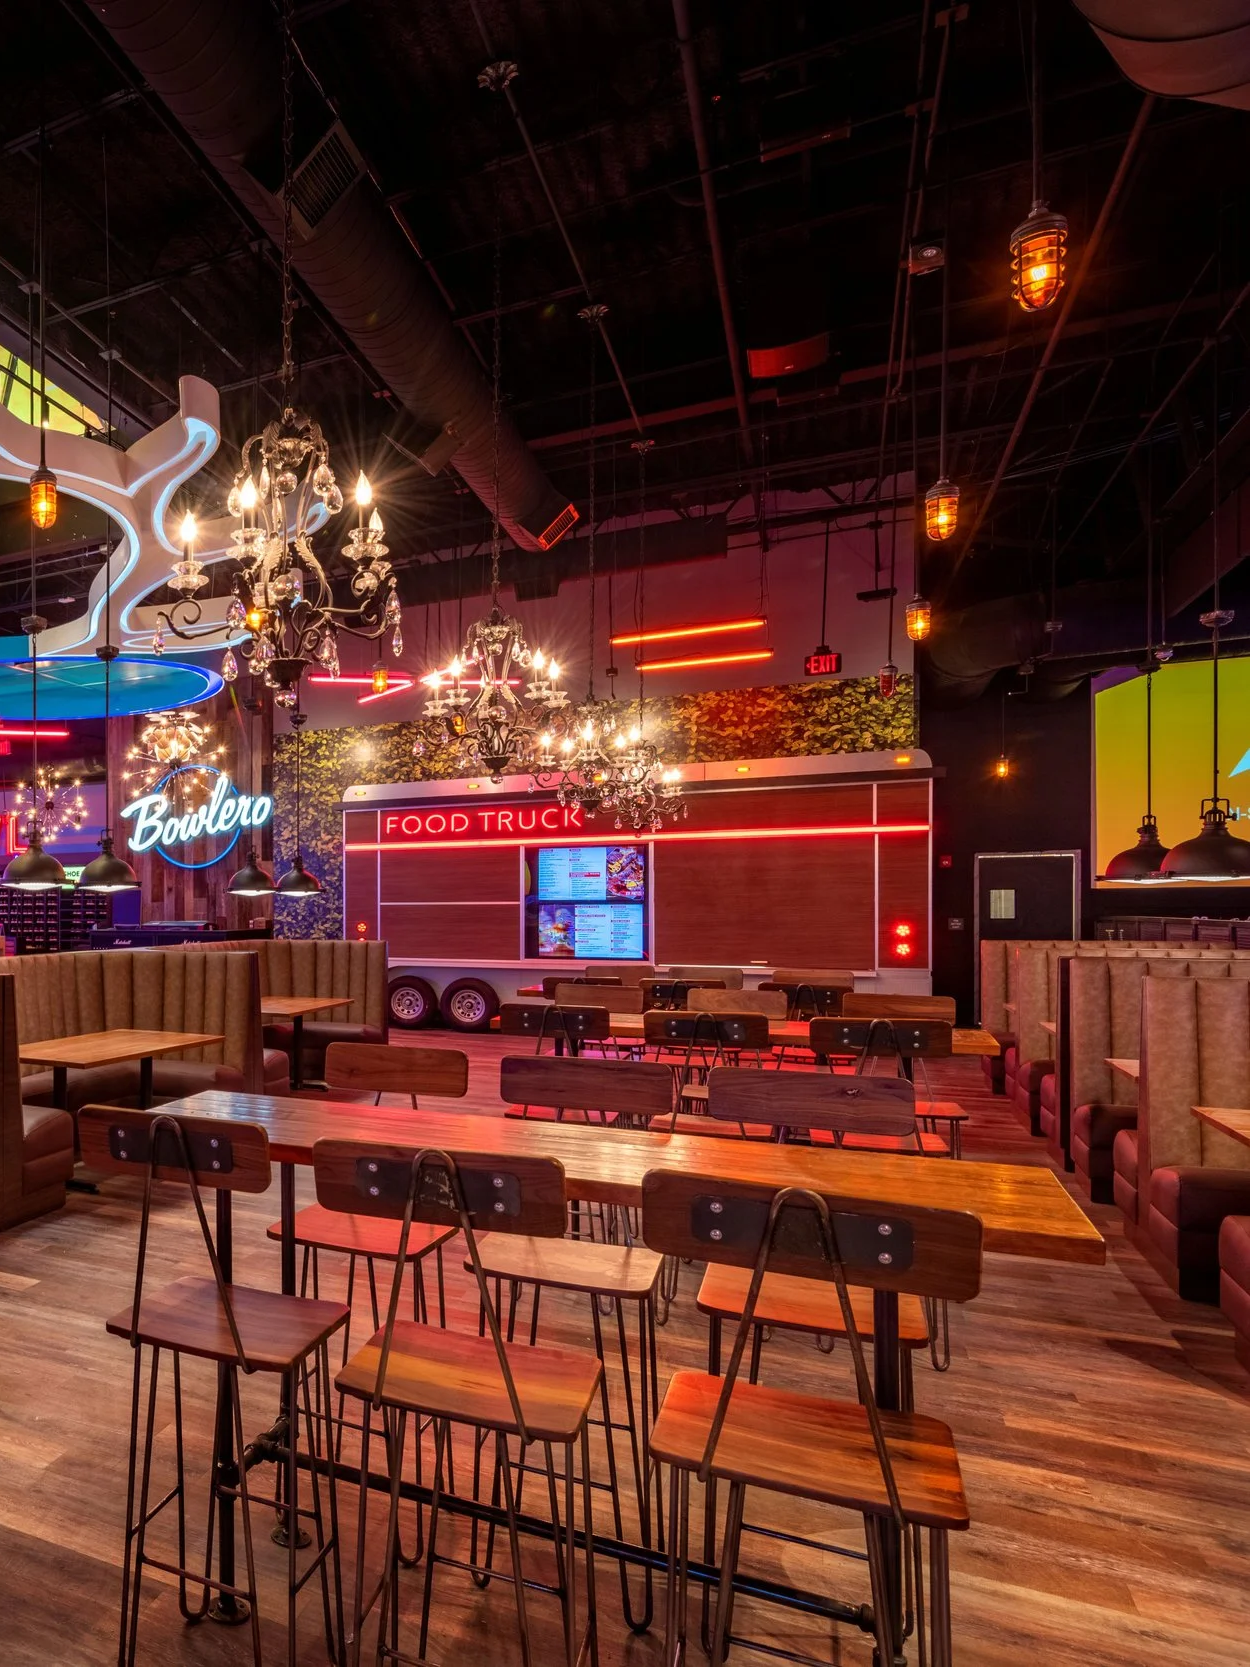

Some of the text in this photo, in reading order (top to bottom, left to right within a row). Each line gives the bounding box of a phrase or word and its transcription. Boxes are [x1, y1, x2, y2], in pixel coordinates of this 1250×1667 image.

[810, 654, 838, 674] EXIT
[120, 775, 272, 852] Bowlero
[386, 808, 582, 835] FOOD TRUCK
